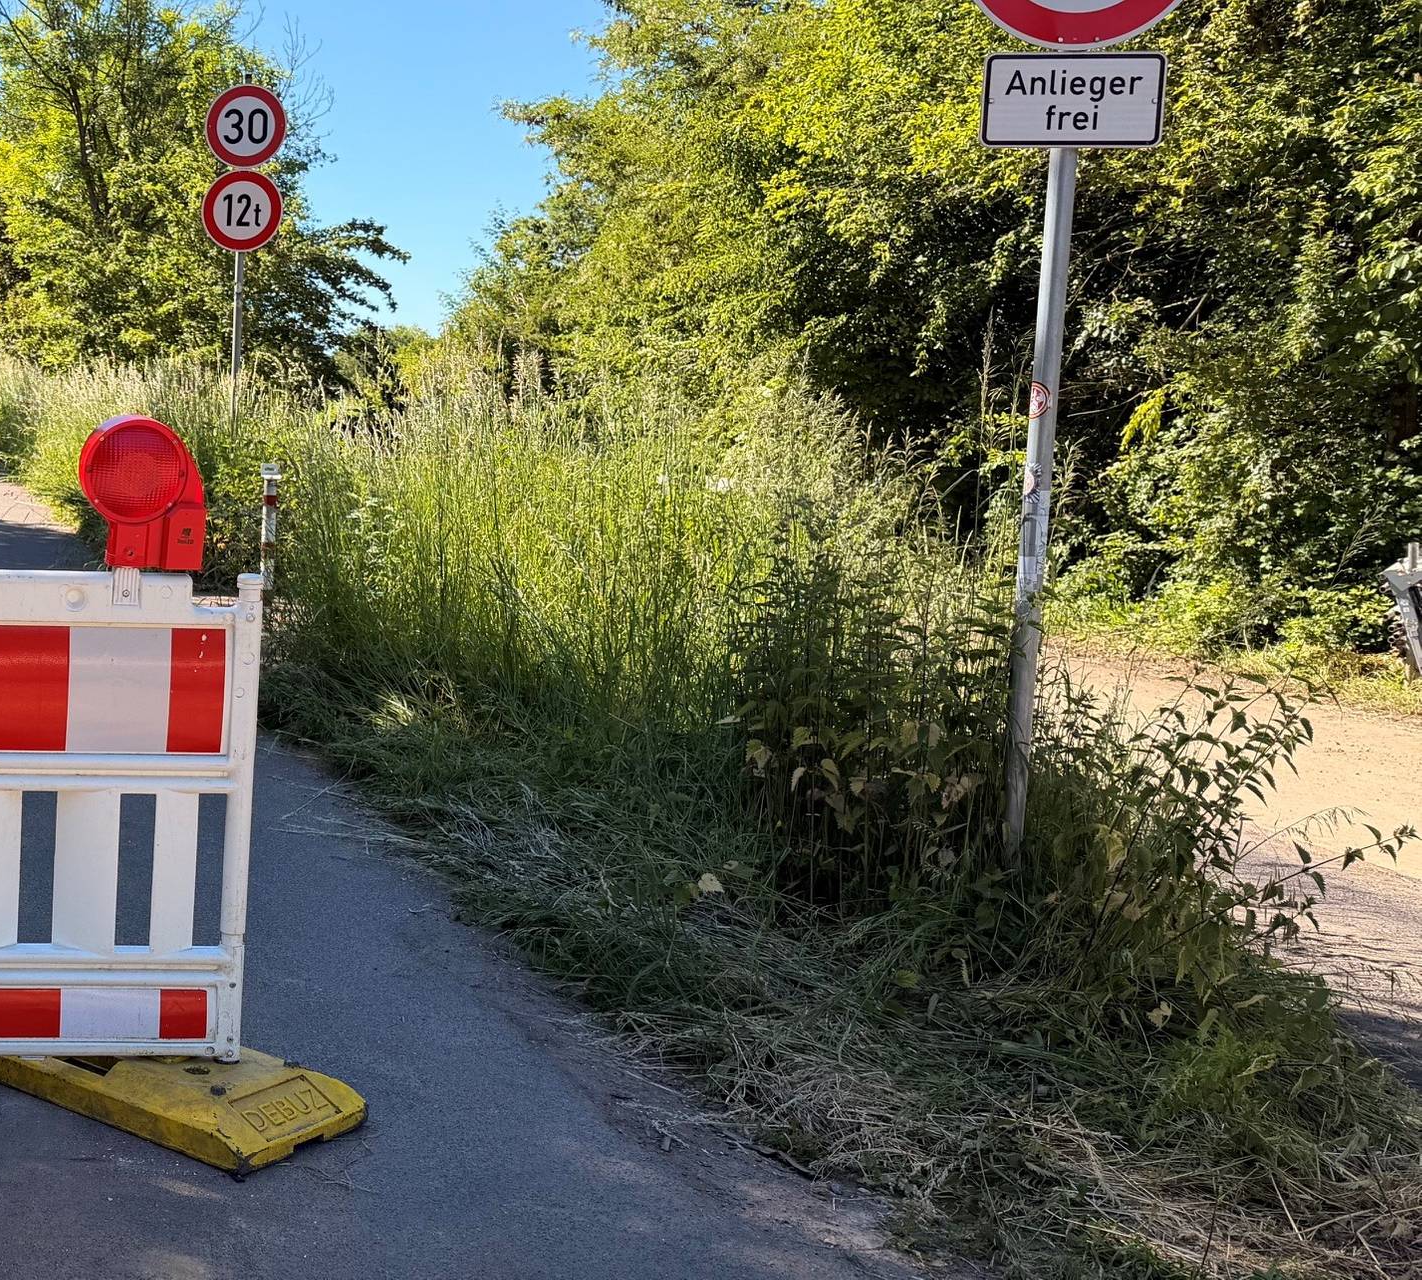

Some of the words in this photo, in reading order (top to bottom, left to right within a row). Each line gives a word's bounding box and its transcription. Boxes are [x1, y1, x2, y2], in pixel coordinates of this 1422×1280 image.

[1005, 69, 1144, 102] Anlieger
[223, 108, 269, 145] 30
[1046, 104, 1099, 131] frei
[223, 193, 262, 227] 12t
[240, 1088, 329, 1132] DEBUZ
